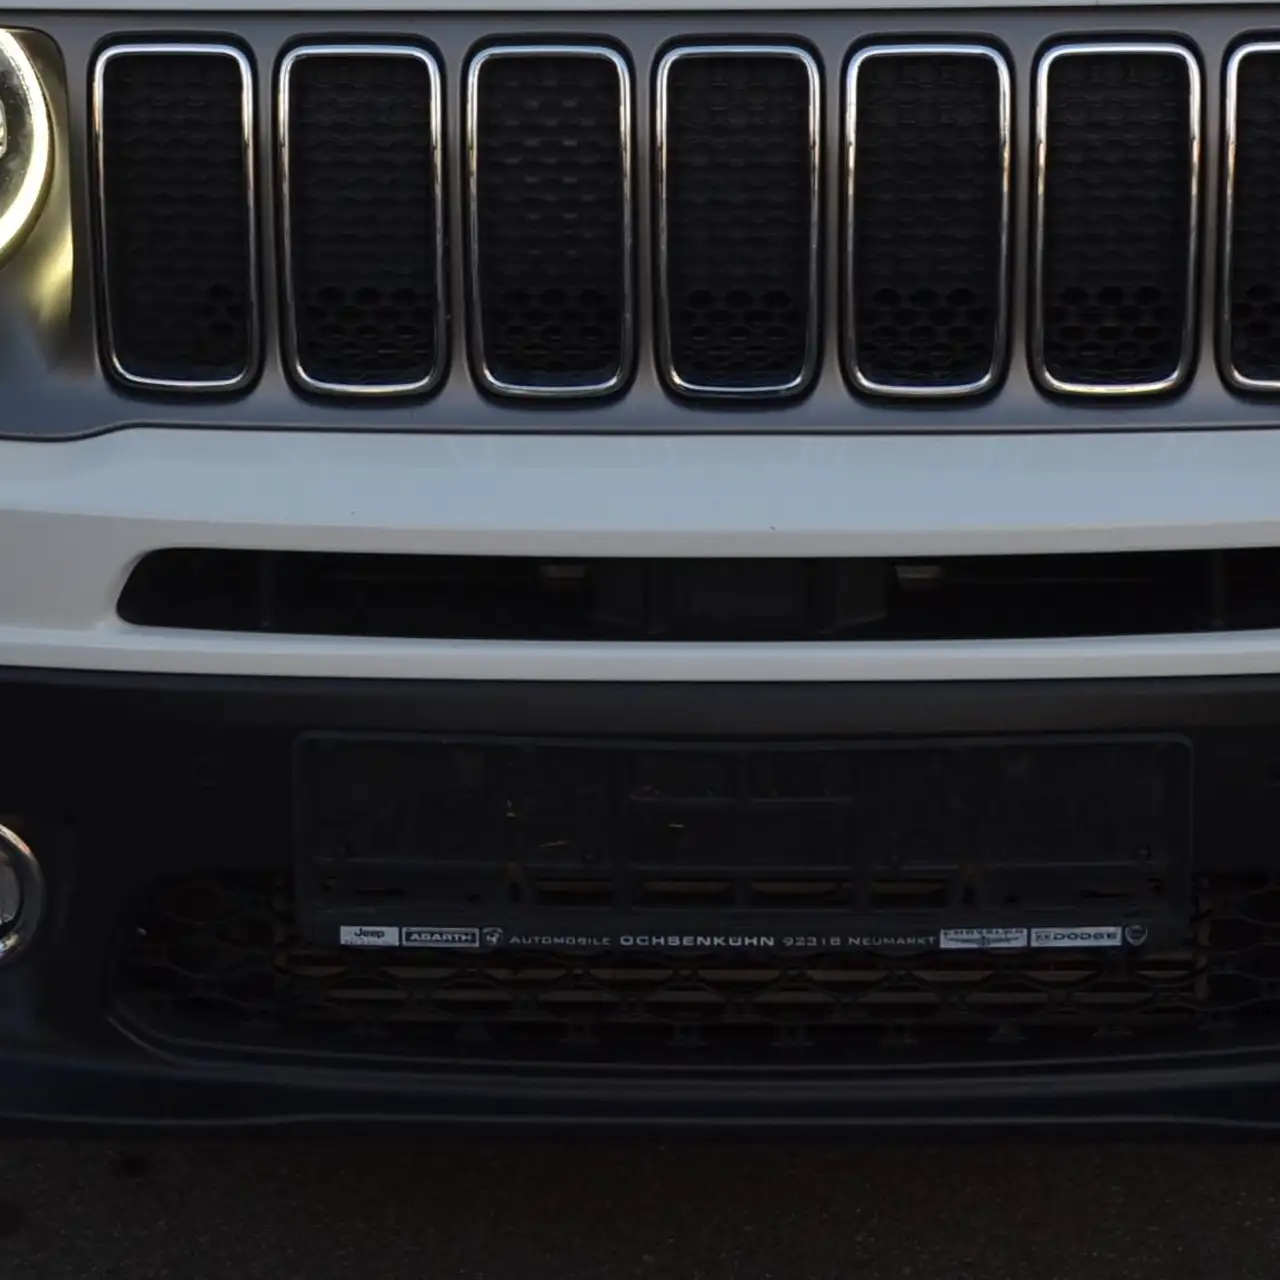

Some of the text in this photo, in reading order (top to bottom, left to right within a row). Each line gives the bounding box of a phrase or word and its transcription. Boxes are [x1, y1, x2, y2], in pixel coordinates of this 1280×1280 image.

[354, 927, 385, 939] Jeep
[1053, 932, 1117, 941] DODGE
[508, 934, 612, 946] AUTOMOBILE
[848, 935, 937, 946] NEUMARKT
